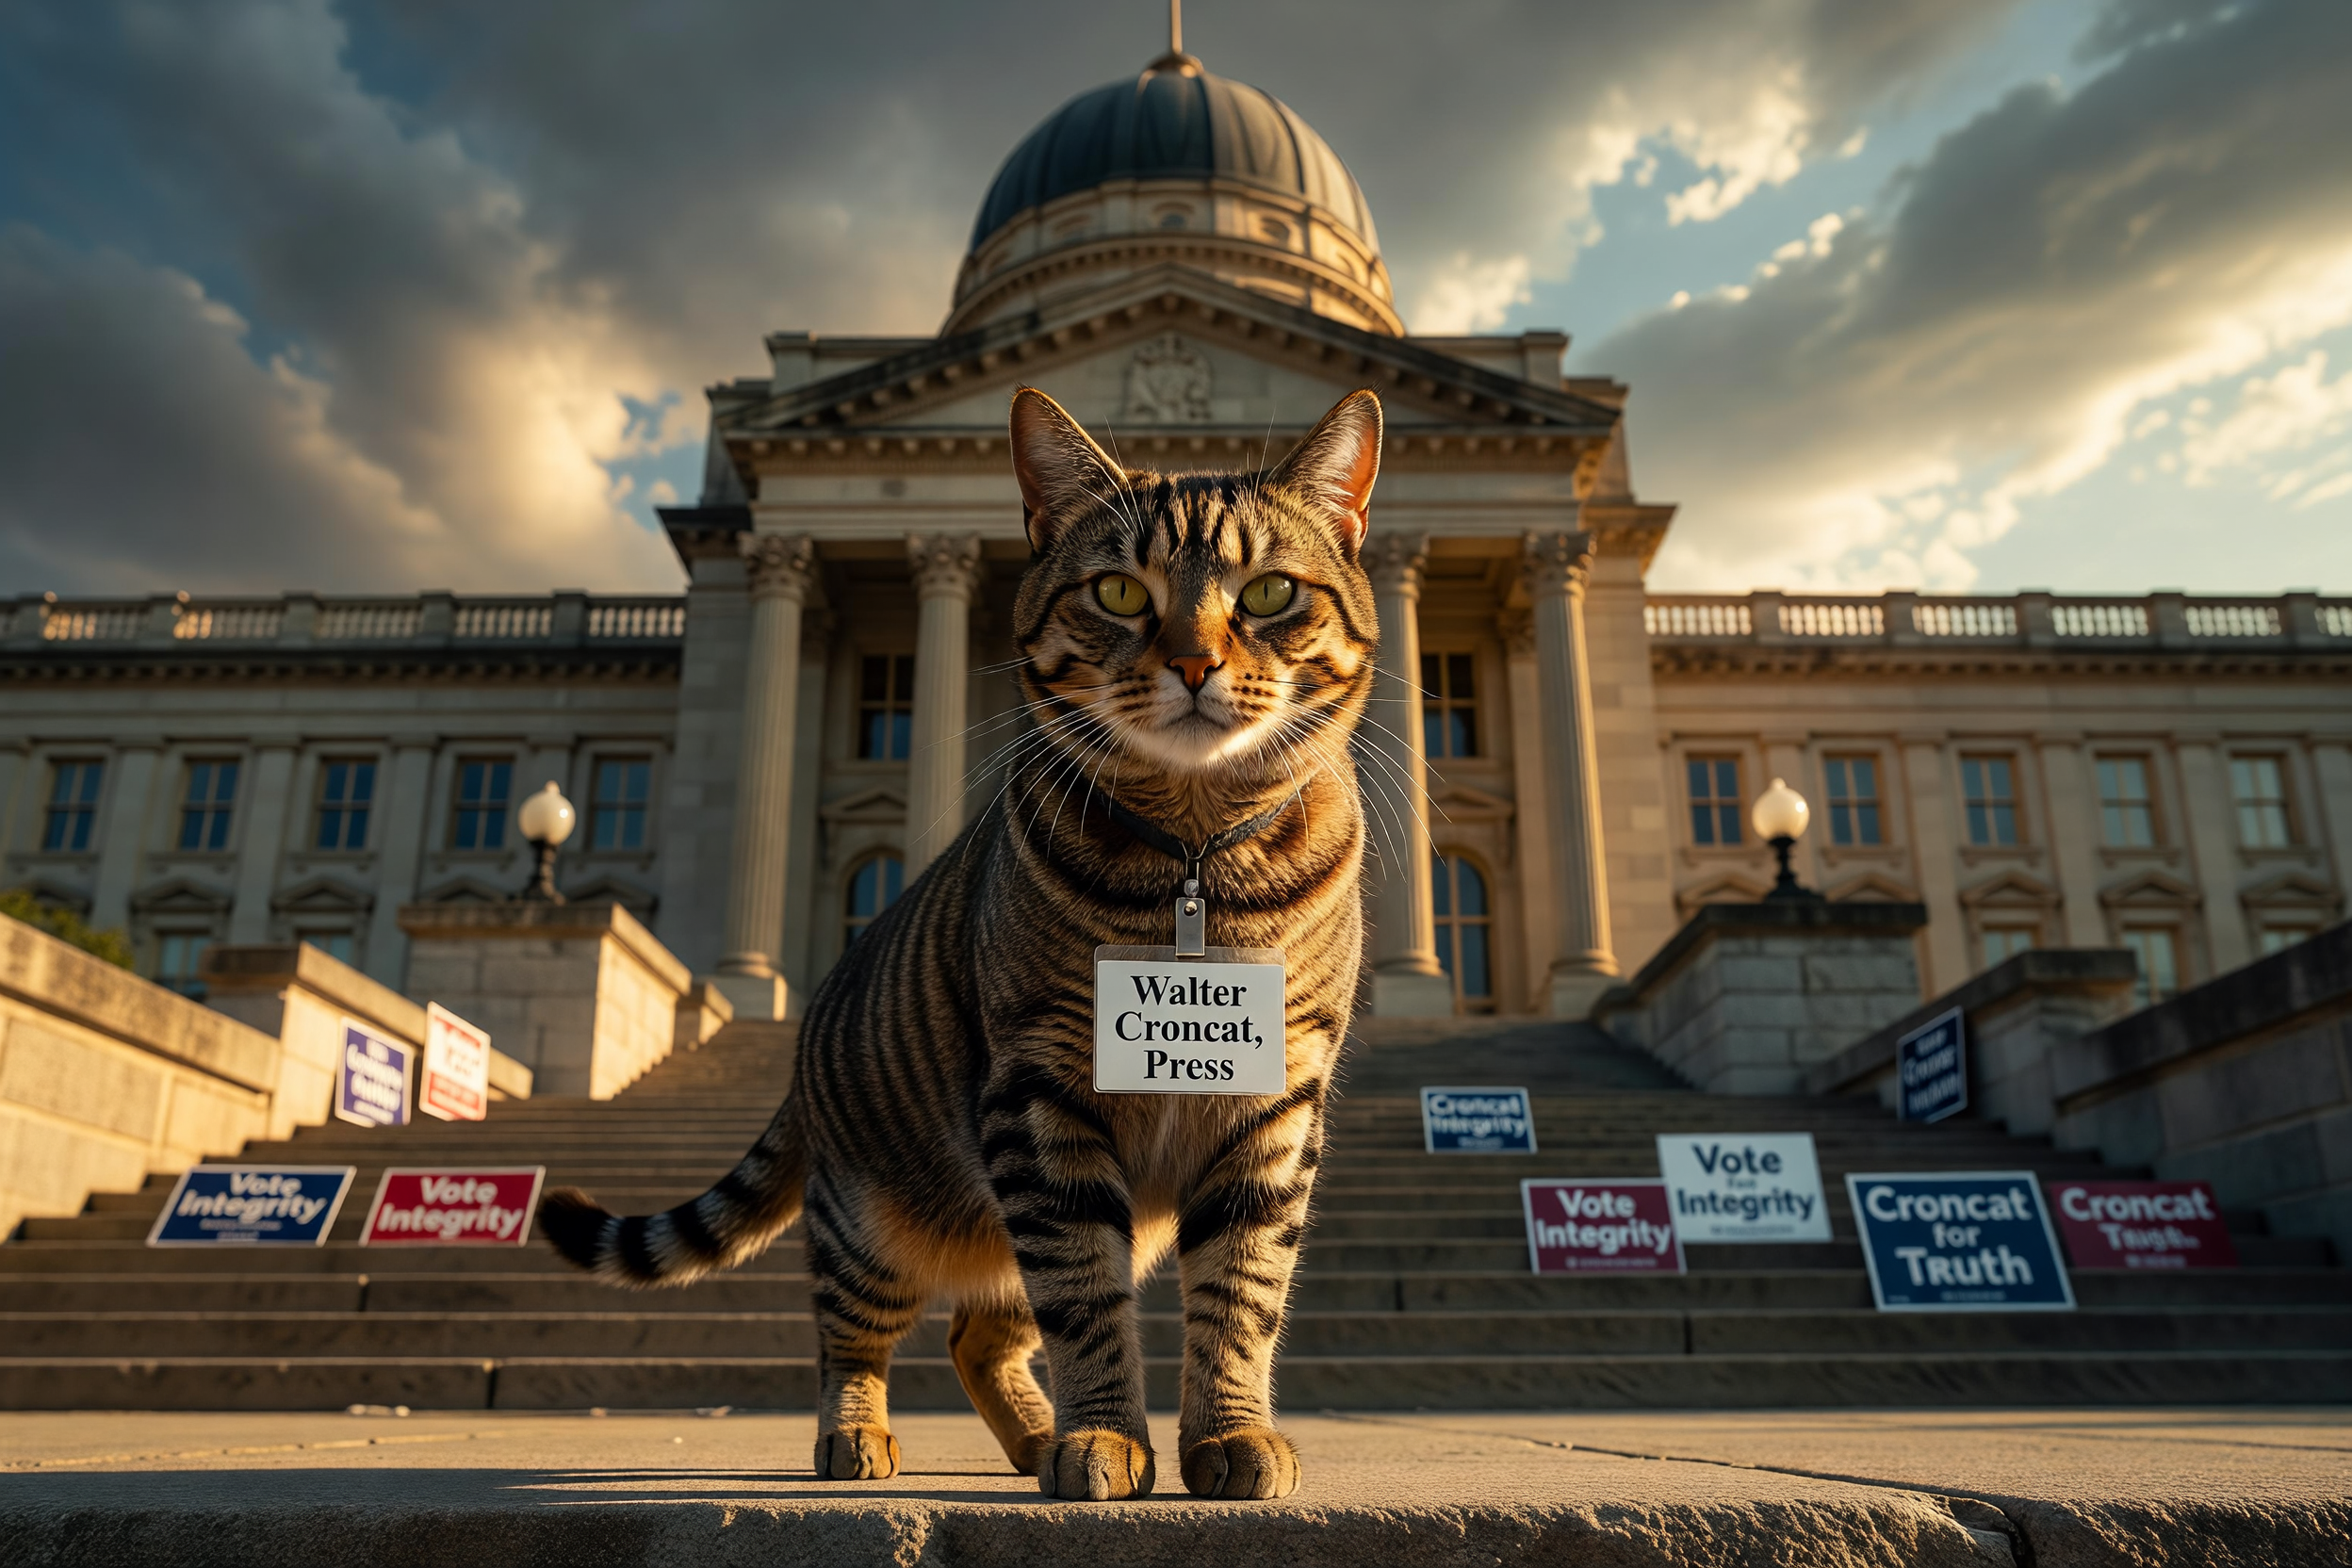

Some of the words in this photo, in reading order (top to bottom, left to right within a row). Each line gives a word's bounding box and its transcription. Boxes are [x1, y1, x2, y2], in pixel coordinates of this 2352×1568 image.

[1130, 975, 1248, 1006] Walter
[1115, 1011, 1263, 1050] Croncat,
[1143, 1050, 1234, 1081] Press
[1691, 1143, 1782, 1175] Vote
[230, 1171, 302, 1198] Vote
[419, 1176, 498, 1205] Vote
[176, 1188, 328, 1225] Integrity
[1556, 1188, 1637, 1218] Vote
[1676, 1186, 1815, 1222] Integrity
[1866, 1184, 2033, 1222] Croncat
[2060, 1186, 2215, 1222] Croncat
[377, 1201, 525, 1240] Integrity
[1535, 1217, 1672, 1256] Integrity
[1932, 1222, 1982, 1249] for
